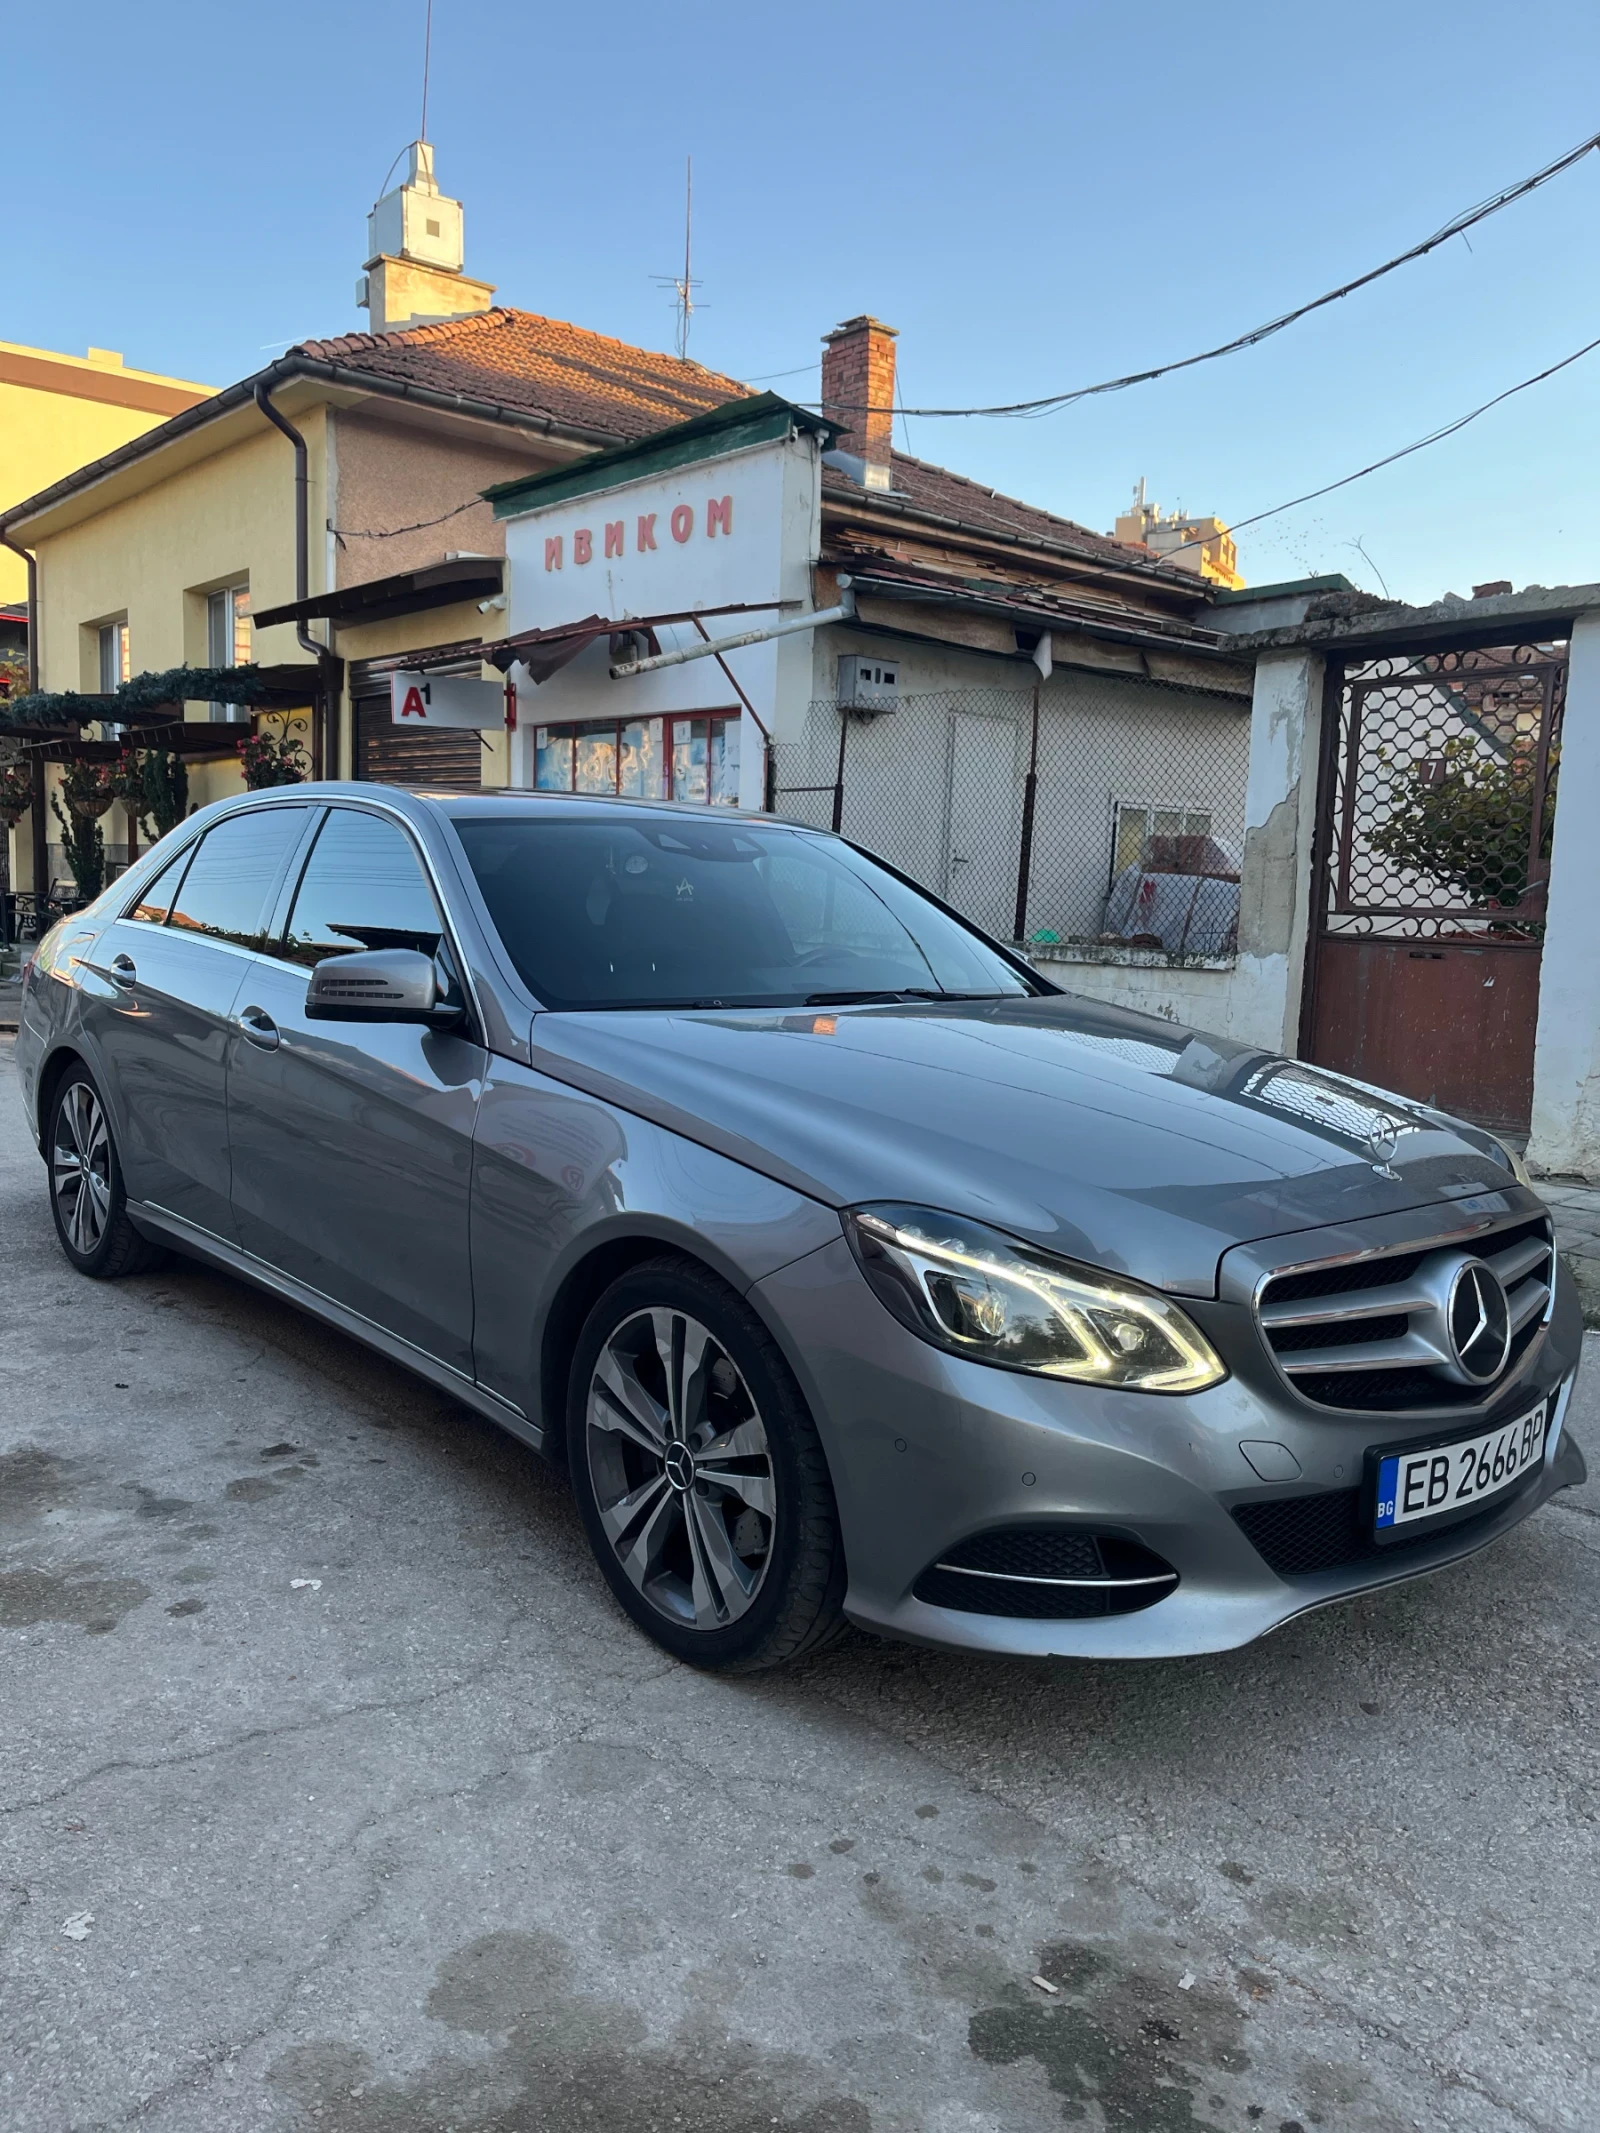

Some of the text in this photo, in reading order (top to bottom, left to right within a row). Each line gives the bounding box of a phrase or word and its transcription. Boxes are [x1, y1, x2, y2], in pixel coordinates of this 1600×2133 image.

[545, 495, 733, 572] ИВИКОМ
[1427, 761, 1437, 780] 7
[1402, 1409, 1544, 1514] EB 2666 BP
[1377, 1500, 1394, 1518] BG
